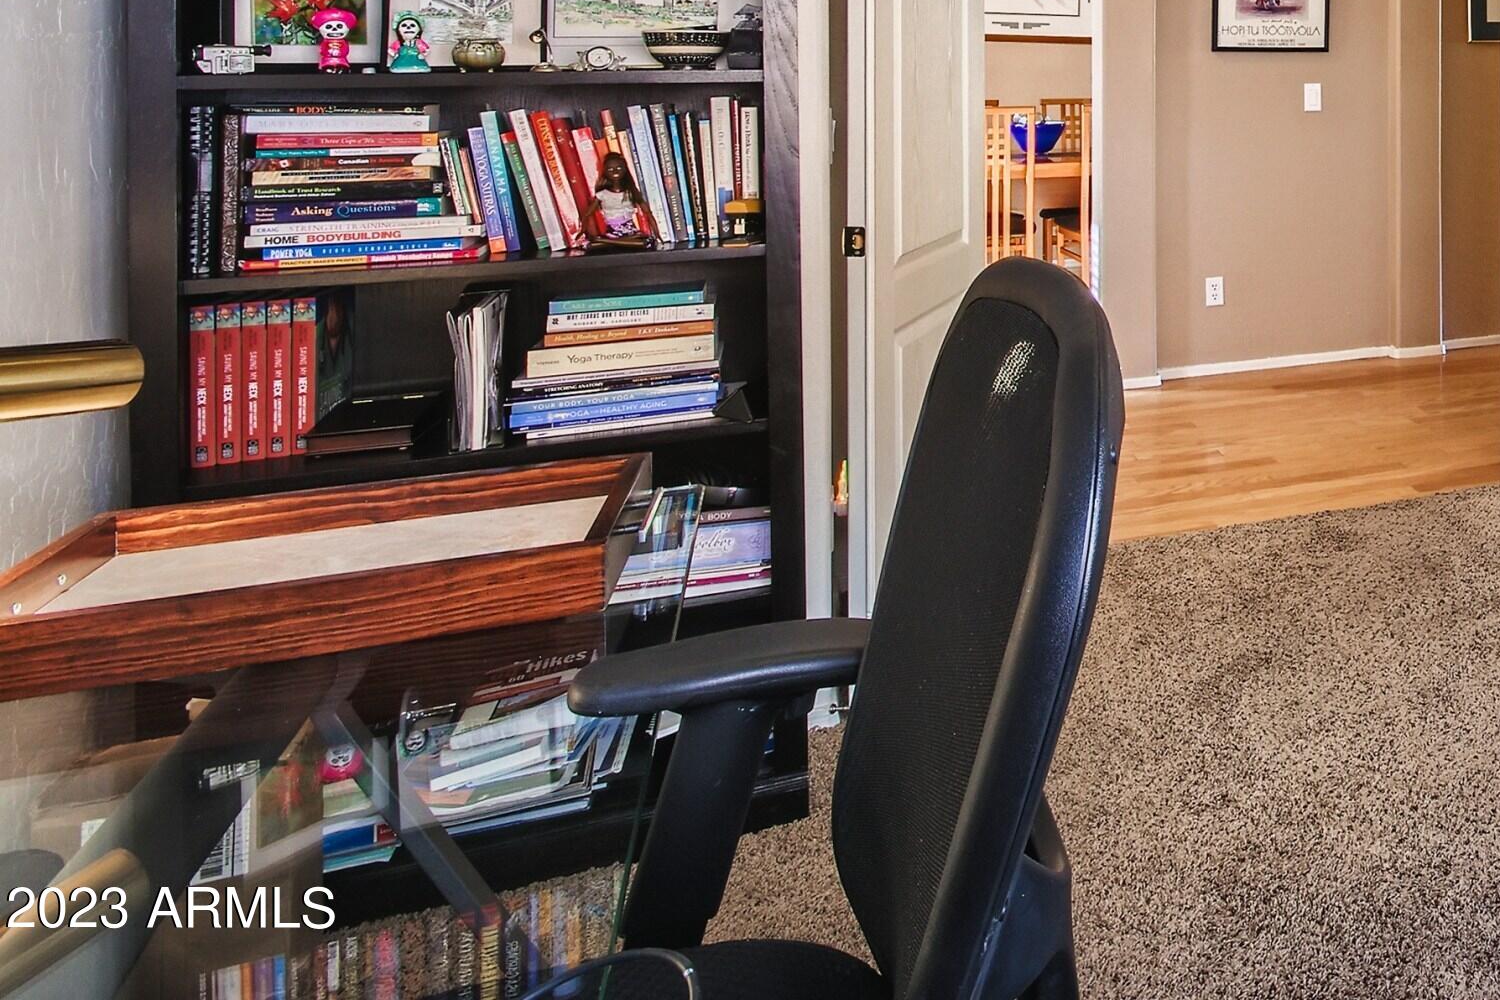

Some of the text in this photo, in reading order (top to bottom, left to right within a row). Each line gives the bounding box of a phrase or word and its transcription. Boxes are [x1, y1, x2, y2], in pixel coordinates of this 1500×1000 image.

[477, 154, 496, 215] YOGA SUTRAS
[291, 203, 396, 218] Asking Questions
[264, 231, 401, 245] HOME BODYBUILDING
[270, 248, 313, 258] POWER YOGA
[568, 351, 633, 364] Yoga Therapy
[223, 385, 233, 402] NECK
[248, 382, 258, 399] NECK
[273, 380, 282, 396] NECK
[298, 377, 308, 394] NECK
[197, 388, 206, 406] NECK
[601, 405, 638, 414] HEALTHY
[640, 401, 667, 409] AGING
[708, 512, 732, 520] BODY
[525, 650, 588, 674] Hikes
